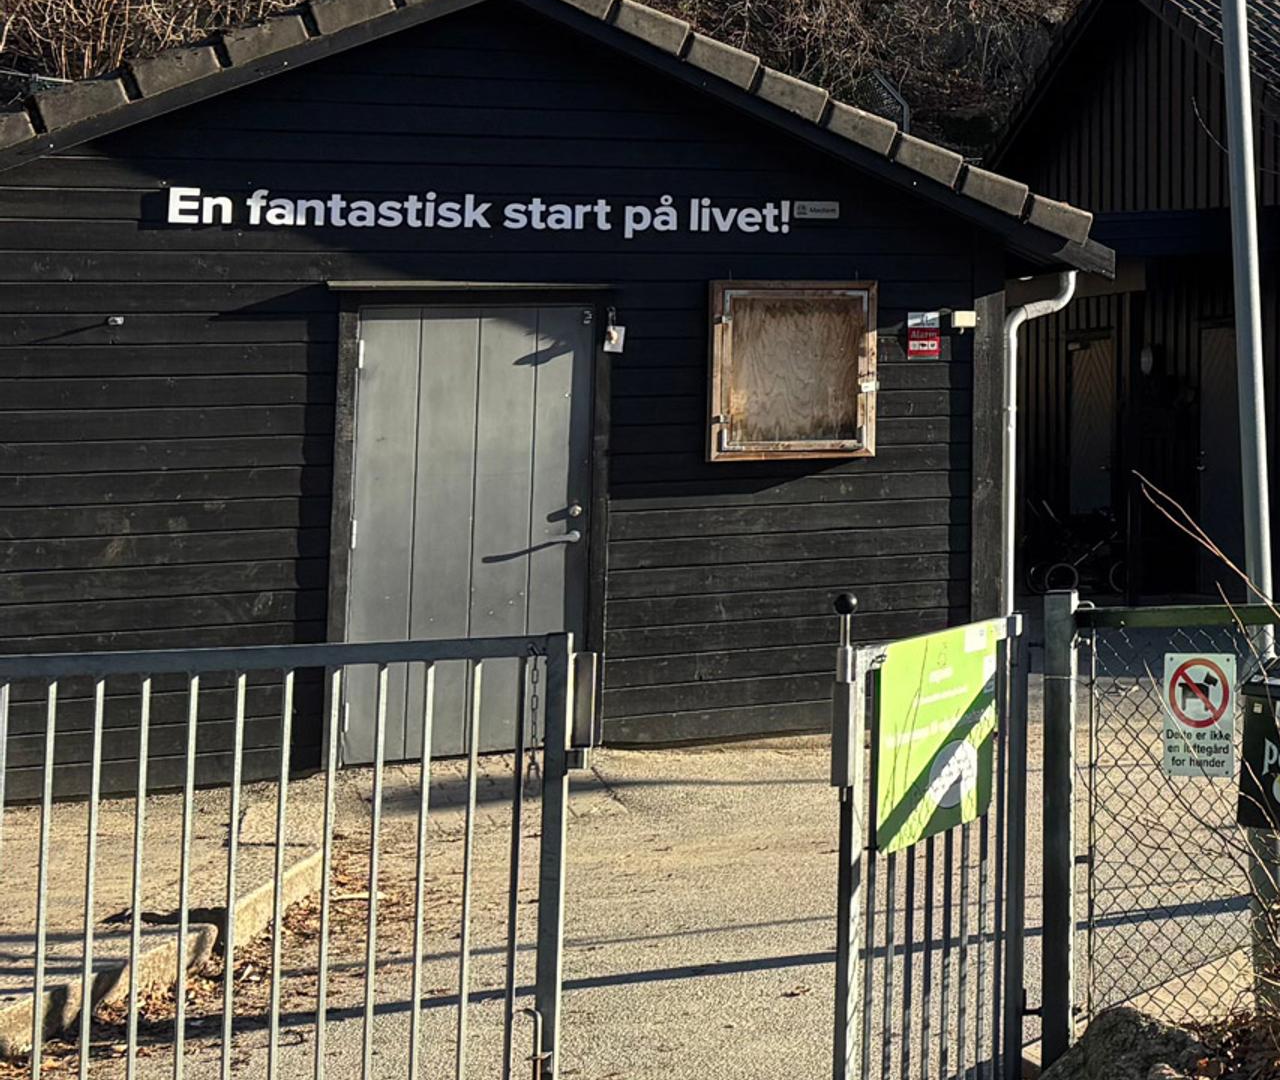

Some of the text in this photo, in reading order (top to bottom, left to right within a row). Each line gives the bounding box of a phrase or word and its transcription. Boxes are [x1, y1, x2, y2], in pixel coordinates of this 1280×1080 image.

[168, 187, 790, 239] En fantastisk start på livet!
[1196, 732, 1206, 740] er
[1210, 730, 1231, 740] ikke
[1167, 745, 1180, 753] en
[1171, 756, 1185, 767] for
